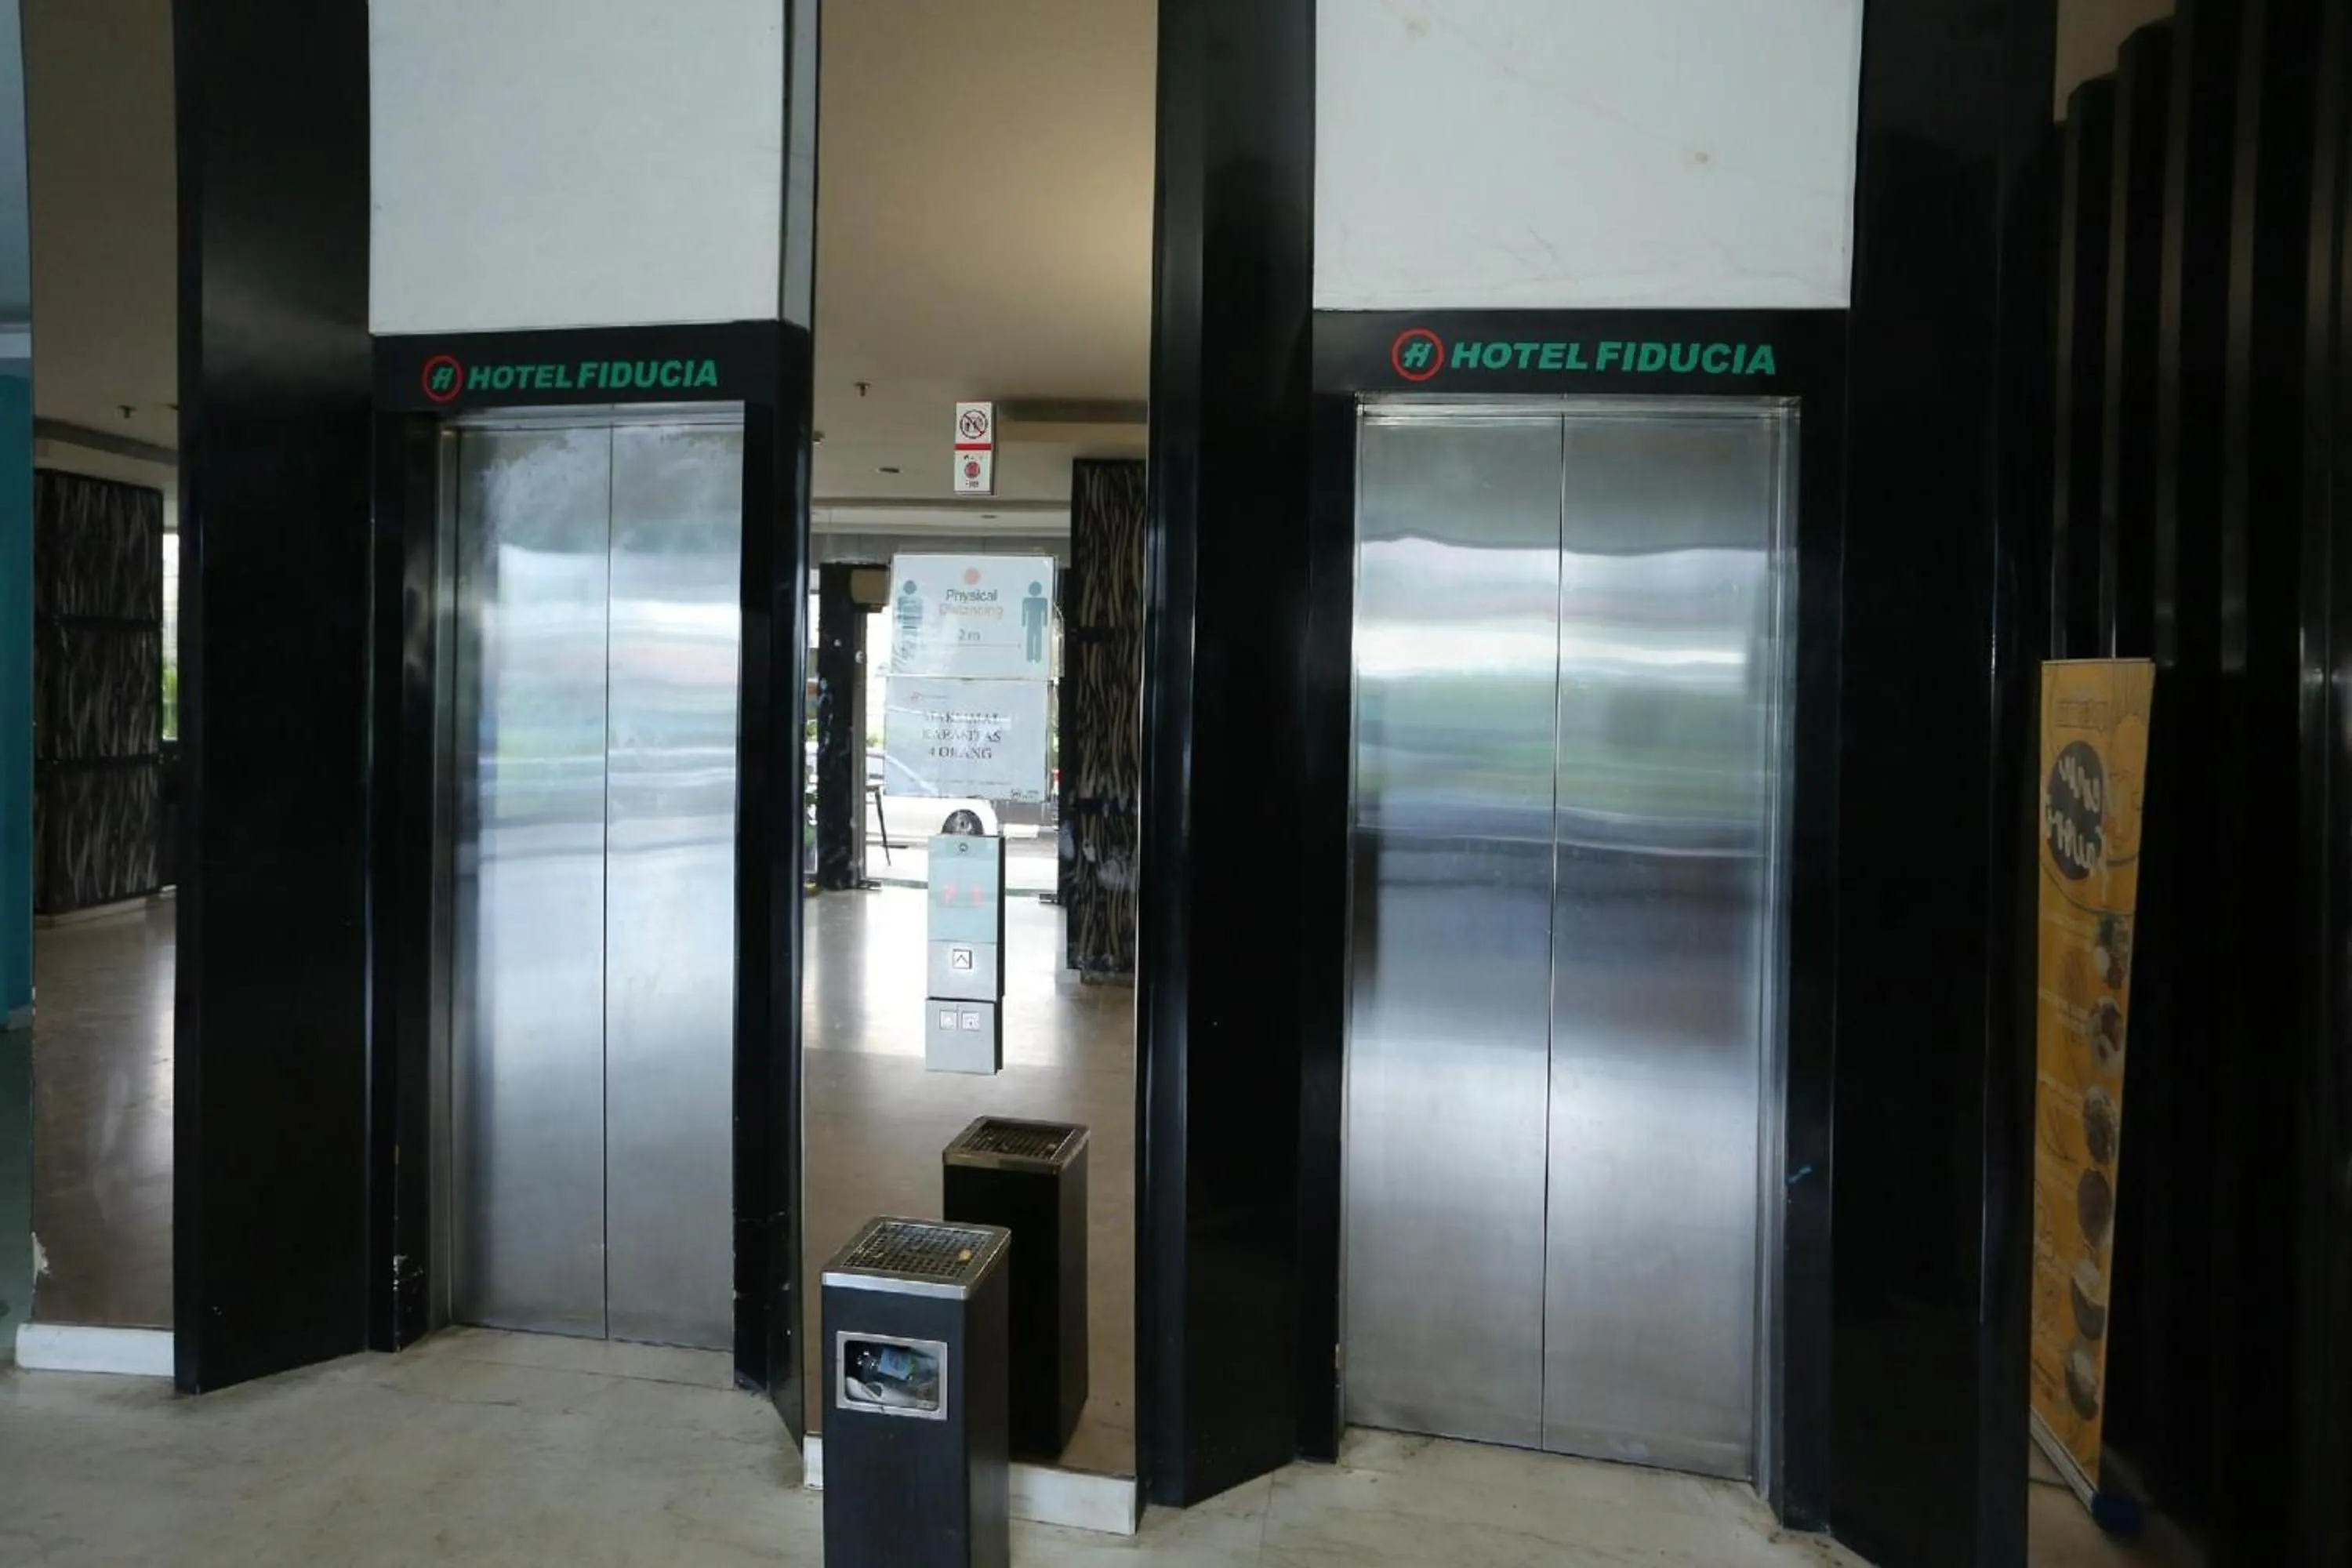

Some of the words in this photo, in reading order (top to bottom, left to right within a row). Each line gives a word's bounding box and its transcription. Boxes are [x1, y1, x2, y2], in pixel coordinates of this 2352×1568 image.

[1450, 342, 1588, 370] HOTEL
[1596, 340, 1776, 375] FIDUCIA
[467, 364, 572, 390] HOTEL
[577, 360, 717, 389] FIDUCIA
[946, 589, 997, 604] Physical
[958, 629, 966, 641] 2
